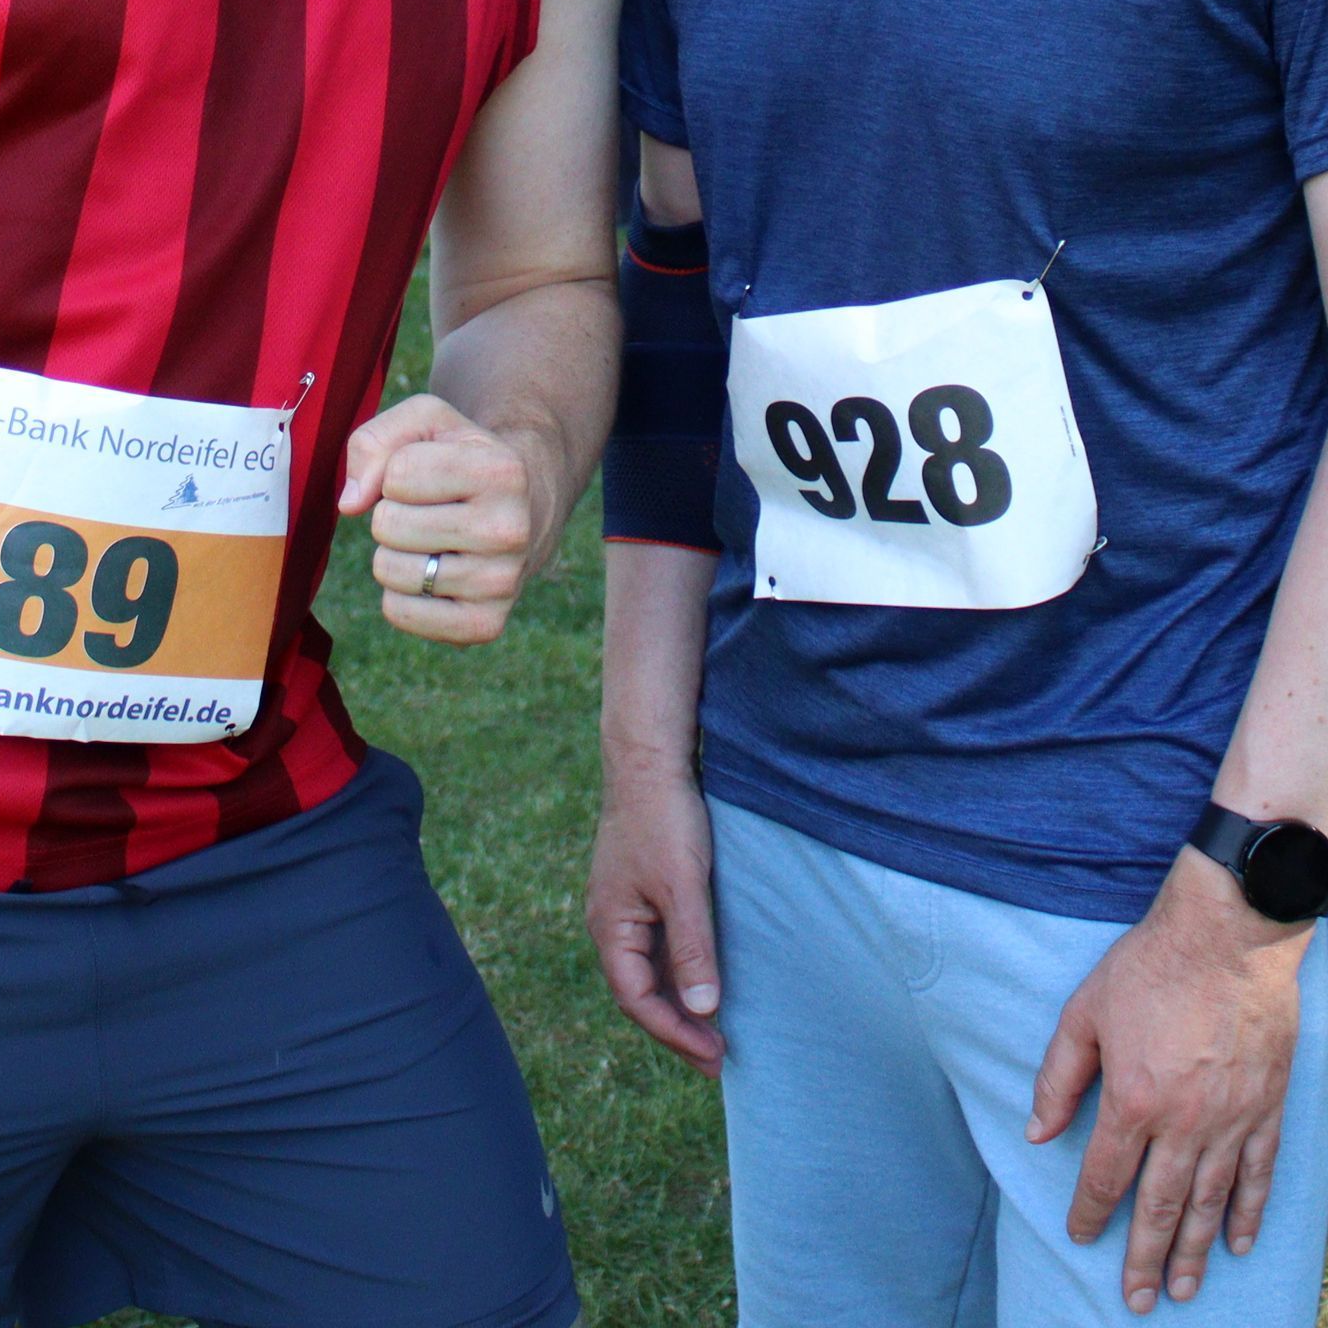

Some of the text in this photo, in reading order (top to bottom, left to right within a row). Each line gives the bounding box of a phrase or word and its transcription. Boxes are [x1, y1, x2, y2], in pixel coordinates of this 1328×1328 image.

[98, 425, 238, 469] Nordeifel
[243, 442, 276, 472] eG
[765, 384, 1012, 527] 928
